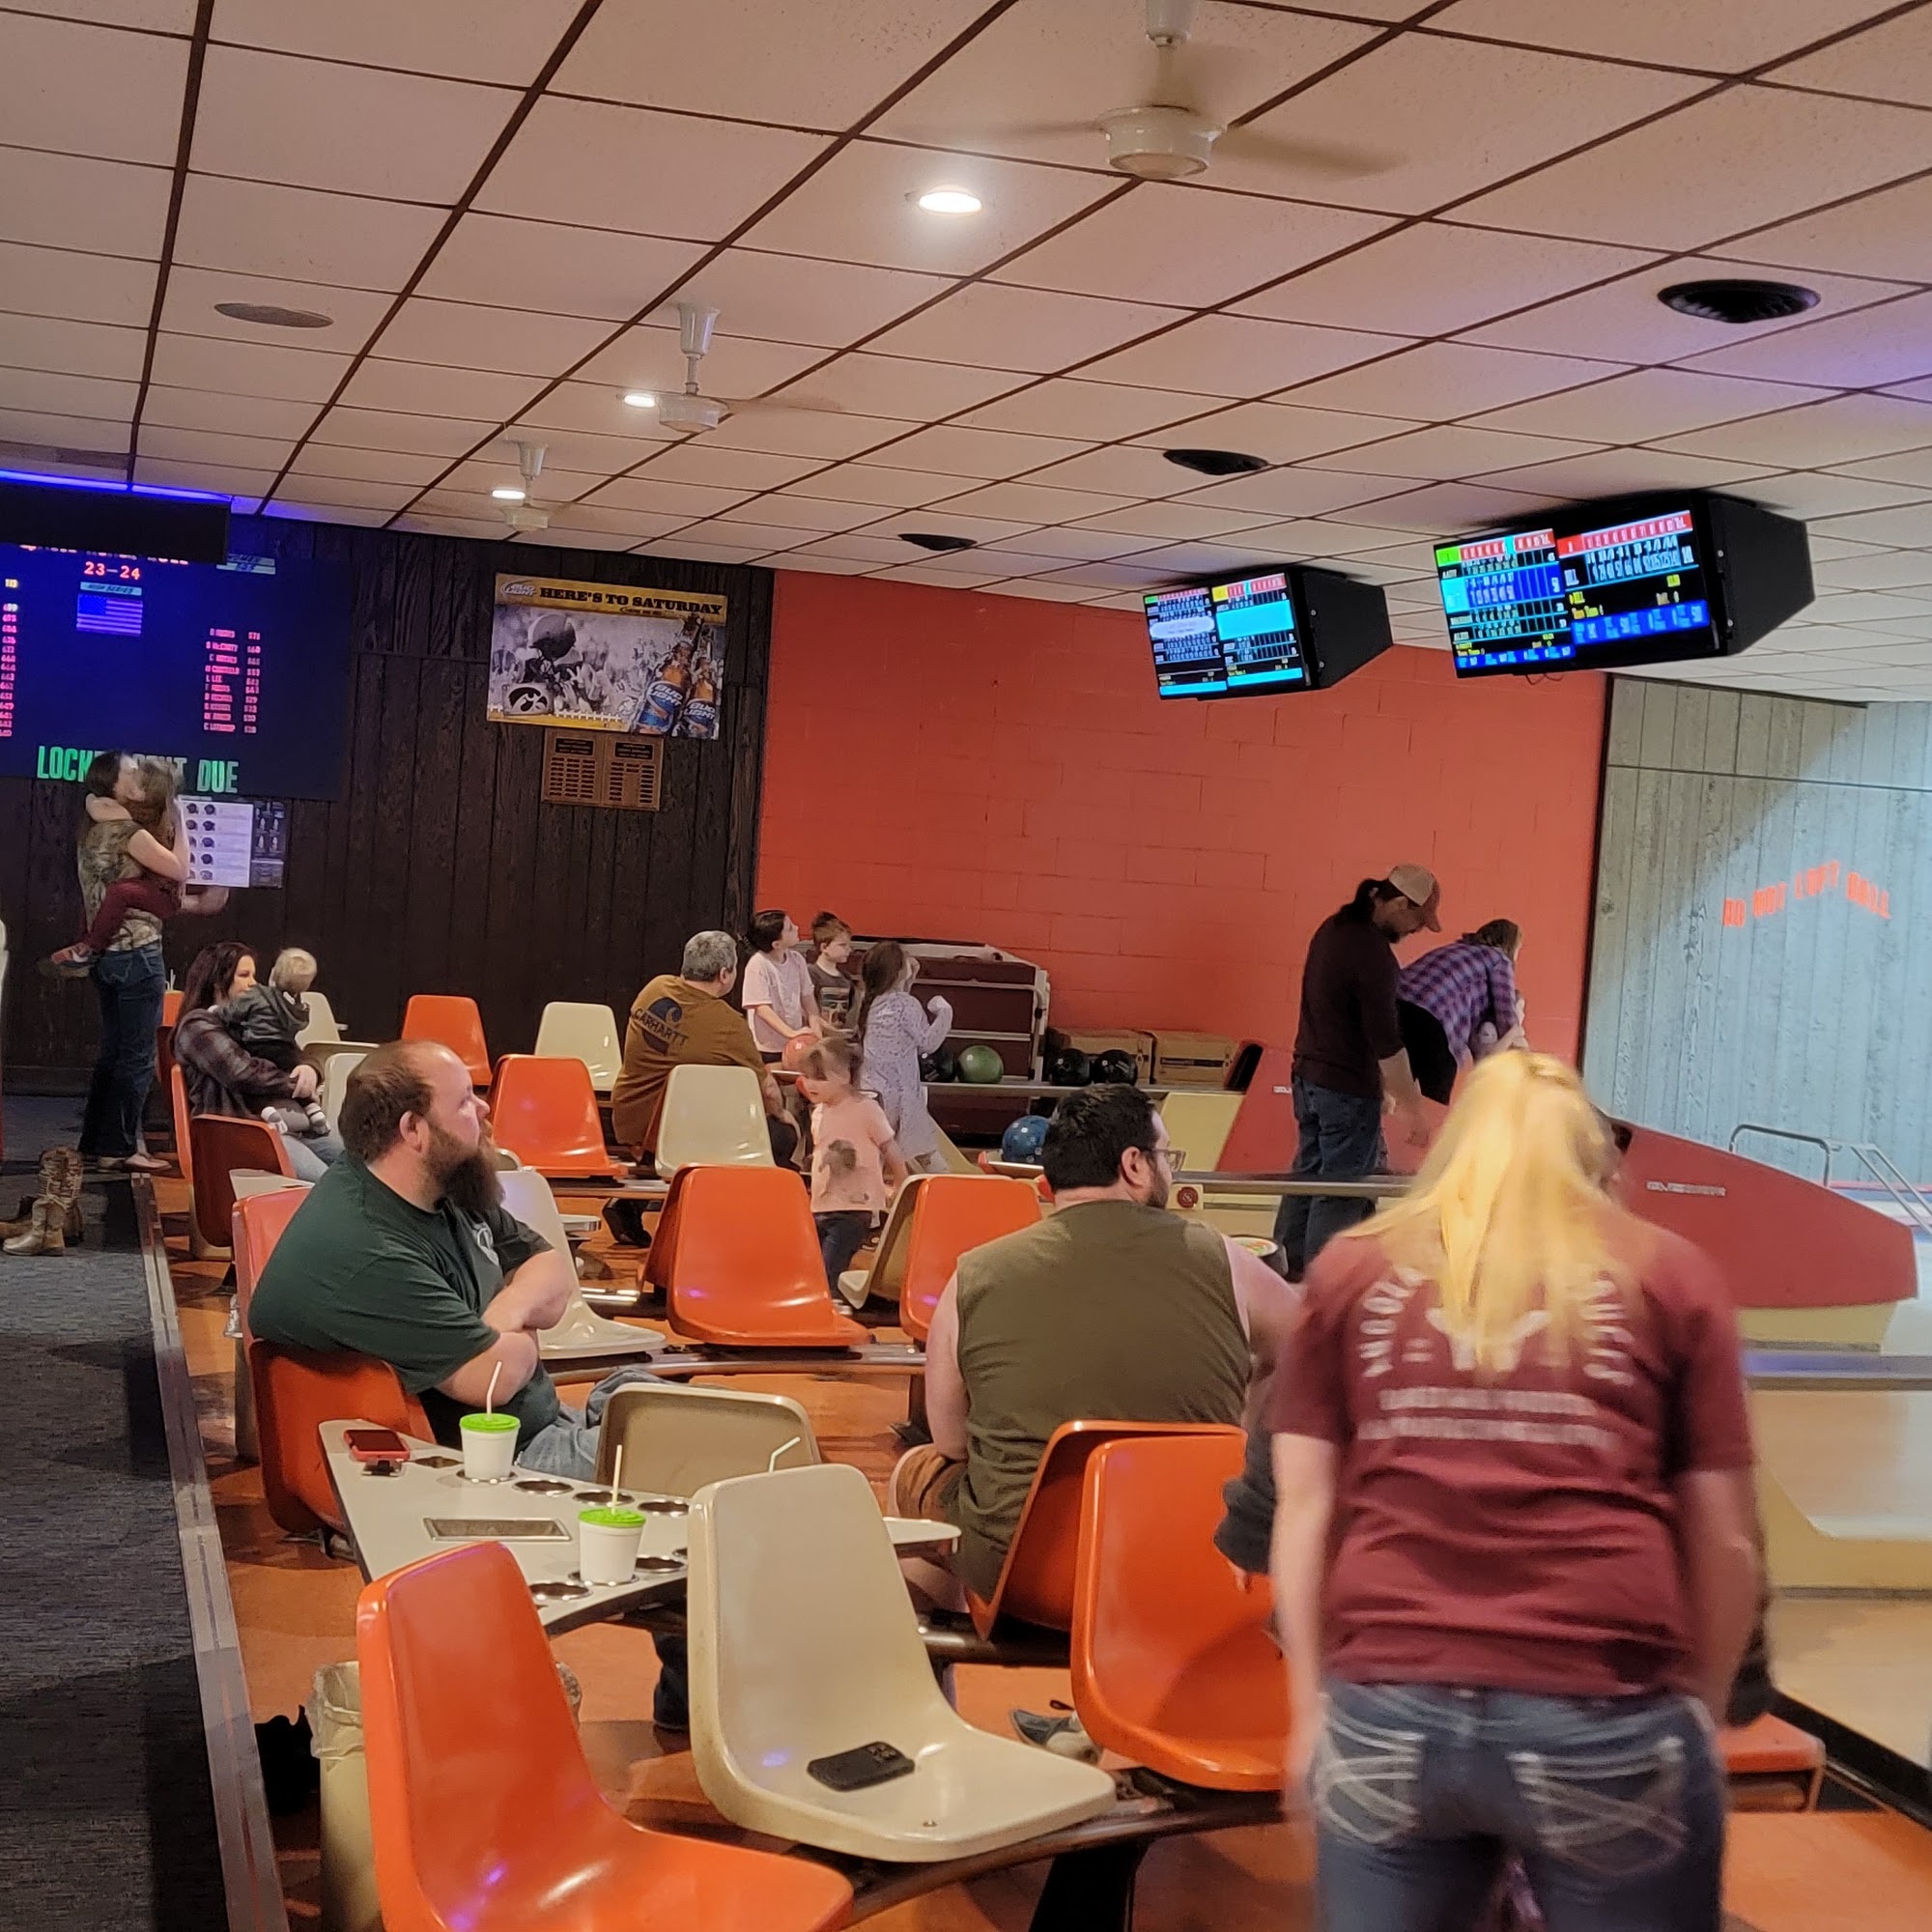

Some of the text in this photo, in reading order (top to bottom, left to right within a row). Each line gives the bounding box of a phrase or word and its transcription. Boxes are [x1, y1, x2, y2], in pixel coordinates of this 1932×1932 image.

[83, 561, 141, 581] 23-24
[539, 587, 724, 615] HERE'S TO SATURDAY
[649, 688, 682, 706] LIGHT
[652, 684, 684, 701] BUD
[683, 708, 716, 720] LIGHT
[689, 702, 716, 714] BUD
[37, 745, 101, 783] LOCK
[196, 758, 240, 794] DUE
[634, 1008, 690, 1046] CARHARTT
